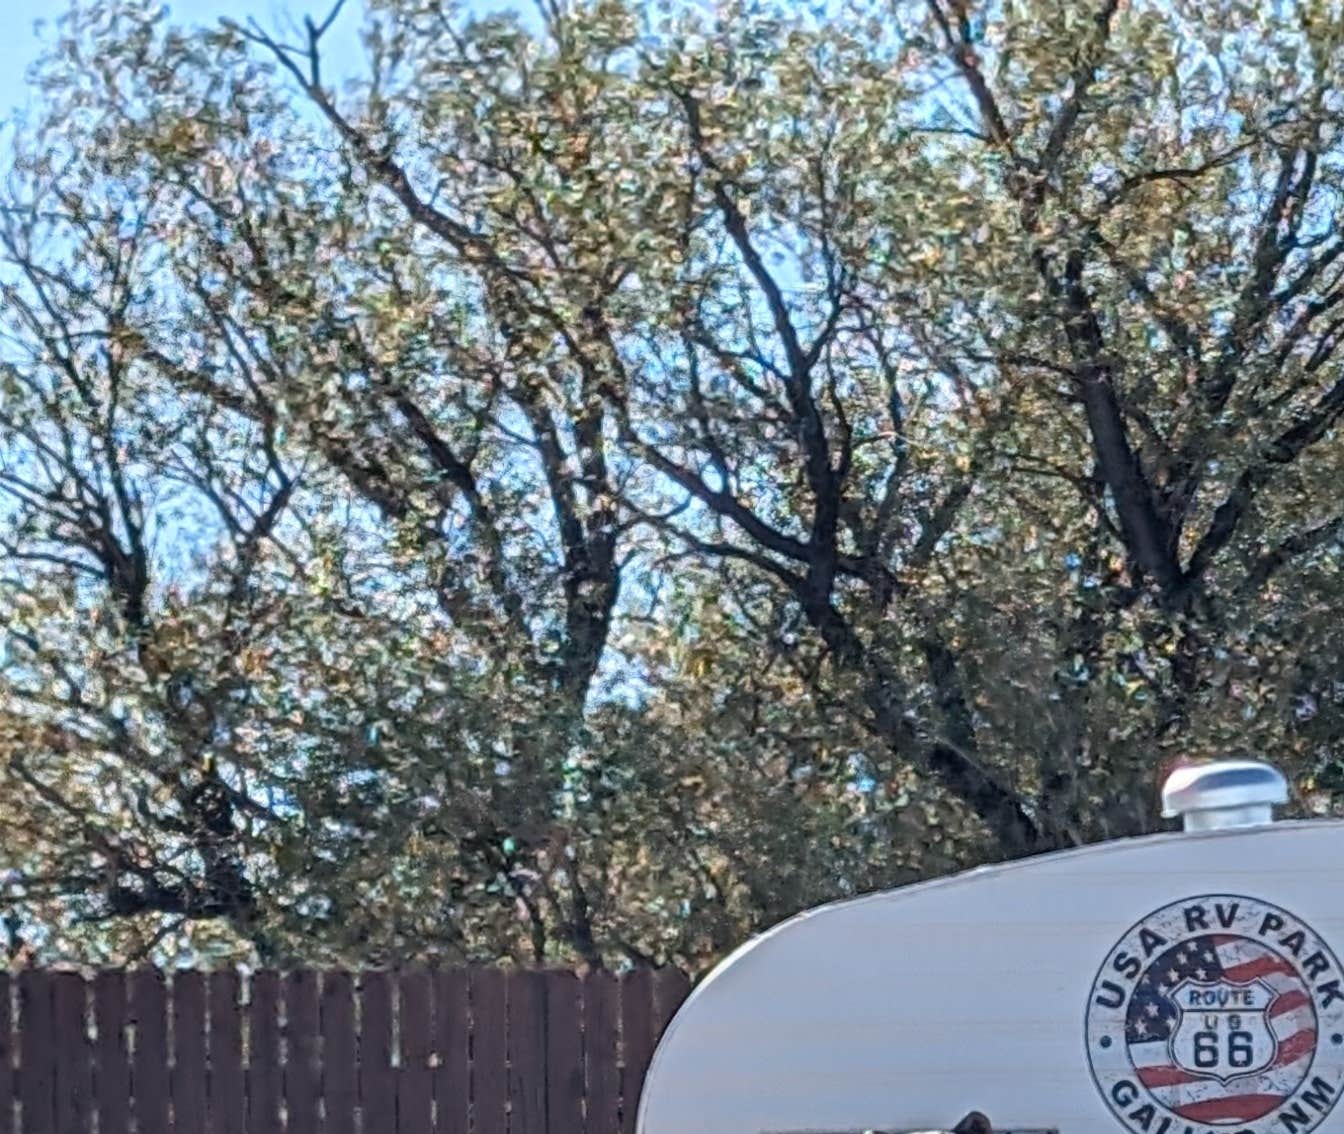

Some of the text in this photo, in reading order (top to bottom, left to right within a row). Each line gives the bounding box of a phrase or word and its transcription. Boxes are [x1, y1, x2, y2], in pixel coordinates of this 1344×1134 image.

[1096, 927, 1167, 1009] USA
[1184, 904, 1239, 932] RV
[1189, 989, 1254, 1007] ROUTE
[1193, 1031, 1254, 1068] 66
[1279, 1076, 1336, 1134] NM
